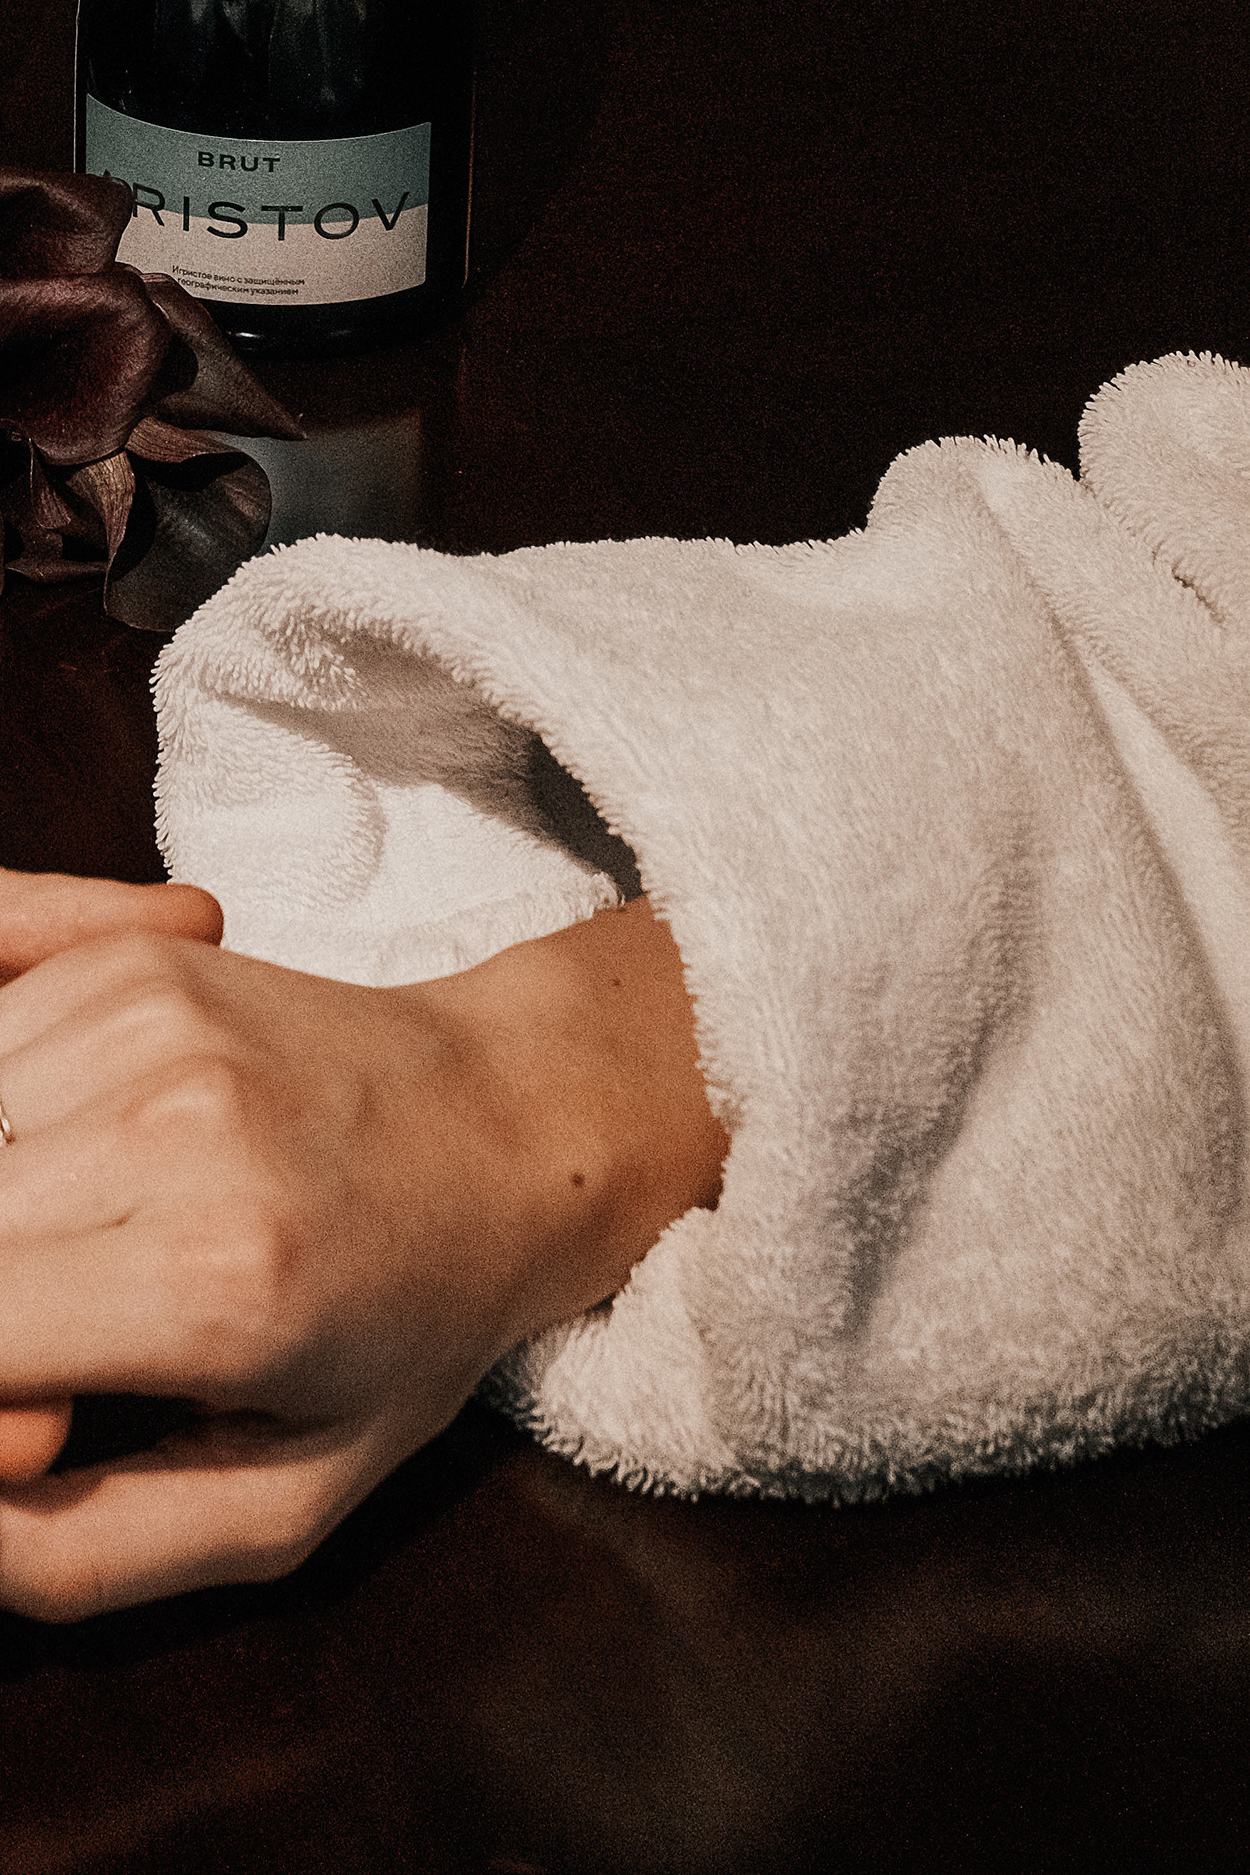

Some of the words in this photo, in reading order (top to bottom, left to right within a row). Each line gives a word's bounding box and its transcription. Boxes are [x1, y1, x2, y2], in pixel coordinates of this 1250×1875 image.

[197, 151, 281, 173] BRUT
[103, 169, 410, 241] RISTOV
[172, 264, 213, 280] Игристое
[213, 274, 236, 284] вино
